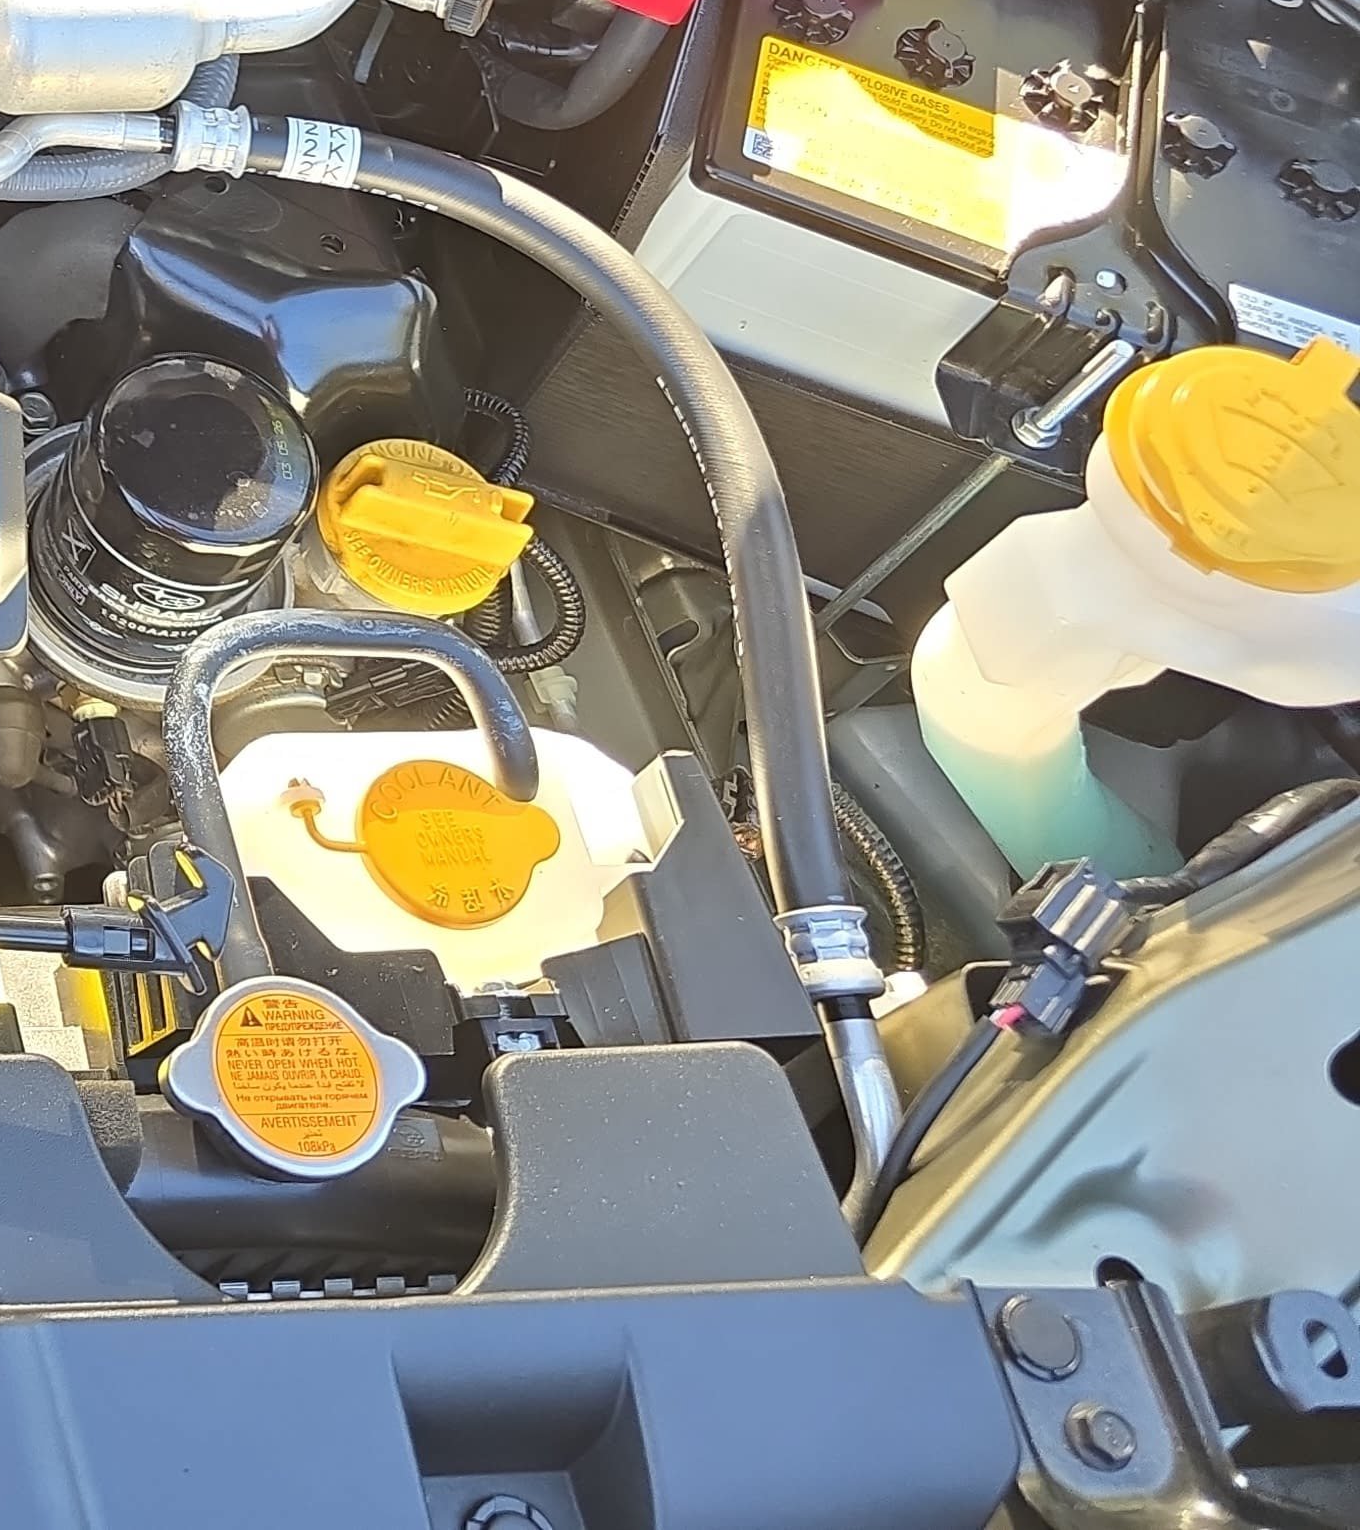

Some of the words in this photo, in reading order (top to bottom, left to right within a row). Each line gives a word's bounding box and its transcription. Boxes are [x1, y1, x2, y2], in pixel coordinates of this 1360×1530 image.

[911, 93, 951, 115] GASES
[304, 122, 318, 136] 2
[329, 125, 347, 140] K
[303, 139, 318, 157] 2
[328, 142, 346, 162] K
[298, 161, 314, 176] 2
[322, 163, 342, 181] K
[344, 529, 371, 558] SEE
[437, 565, 496, 597] MANUAL
[99, 582, 222, 621] SUBARU
[370, 765, 501, 820] COOLANT
[419, 811, 456, 830] SEE
[418, 846, 493, 866] MANUAL
[262, 1009, 325, 1021] WARNING
[228, 1059, 263, 1070] NEVER
[267, 1058, 296, 1069] OPEN
[301, 1058, 332, 1068] WHEN
[231, 1071, 244, 1081] NE
[247, 1070, 279, 1081] JAMAIS
[282, 1070, 316, 1080] OUVRIR
[261, 1114, 358, 1128] AVERTISSEMENT
[298, 1140, 336, 1153] 108kPa
